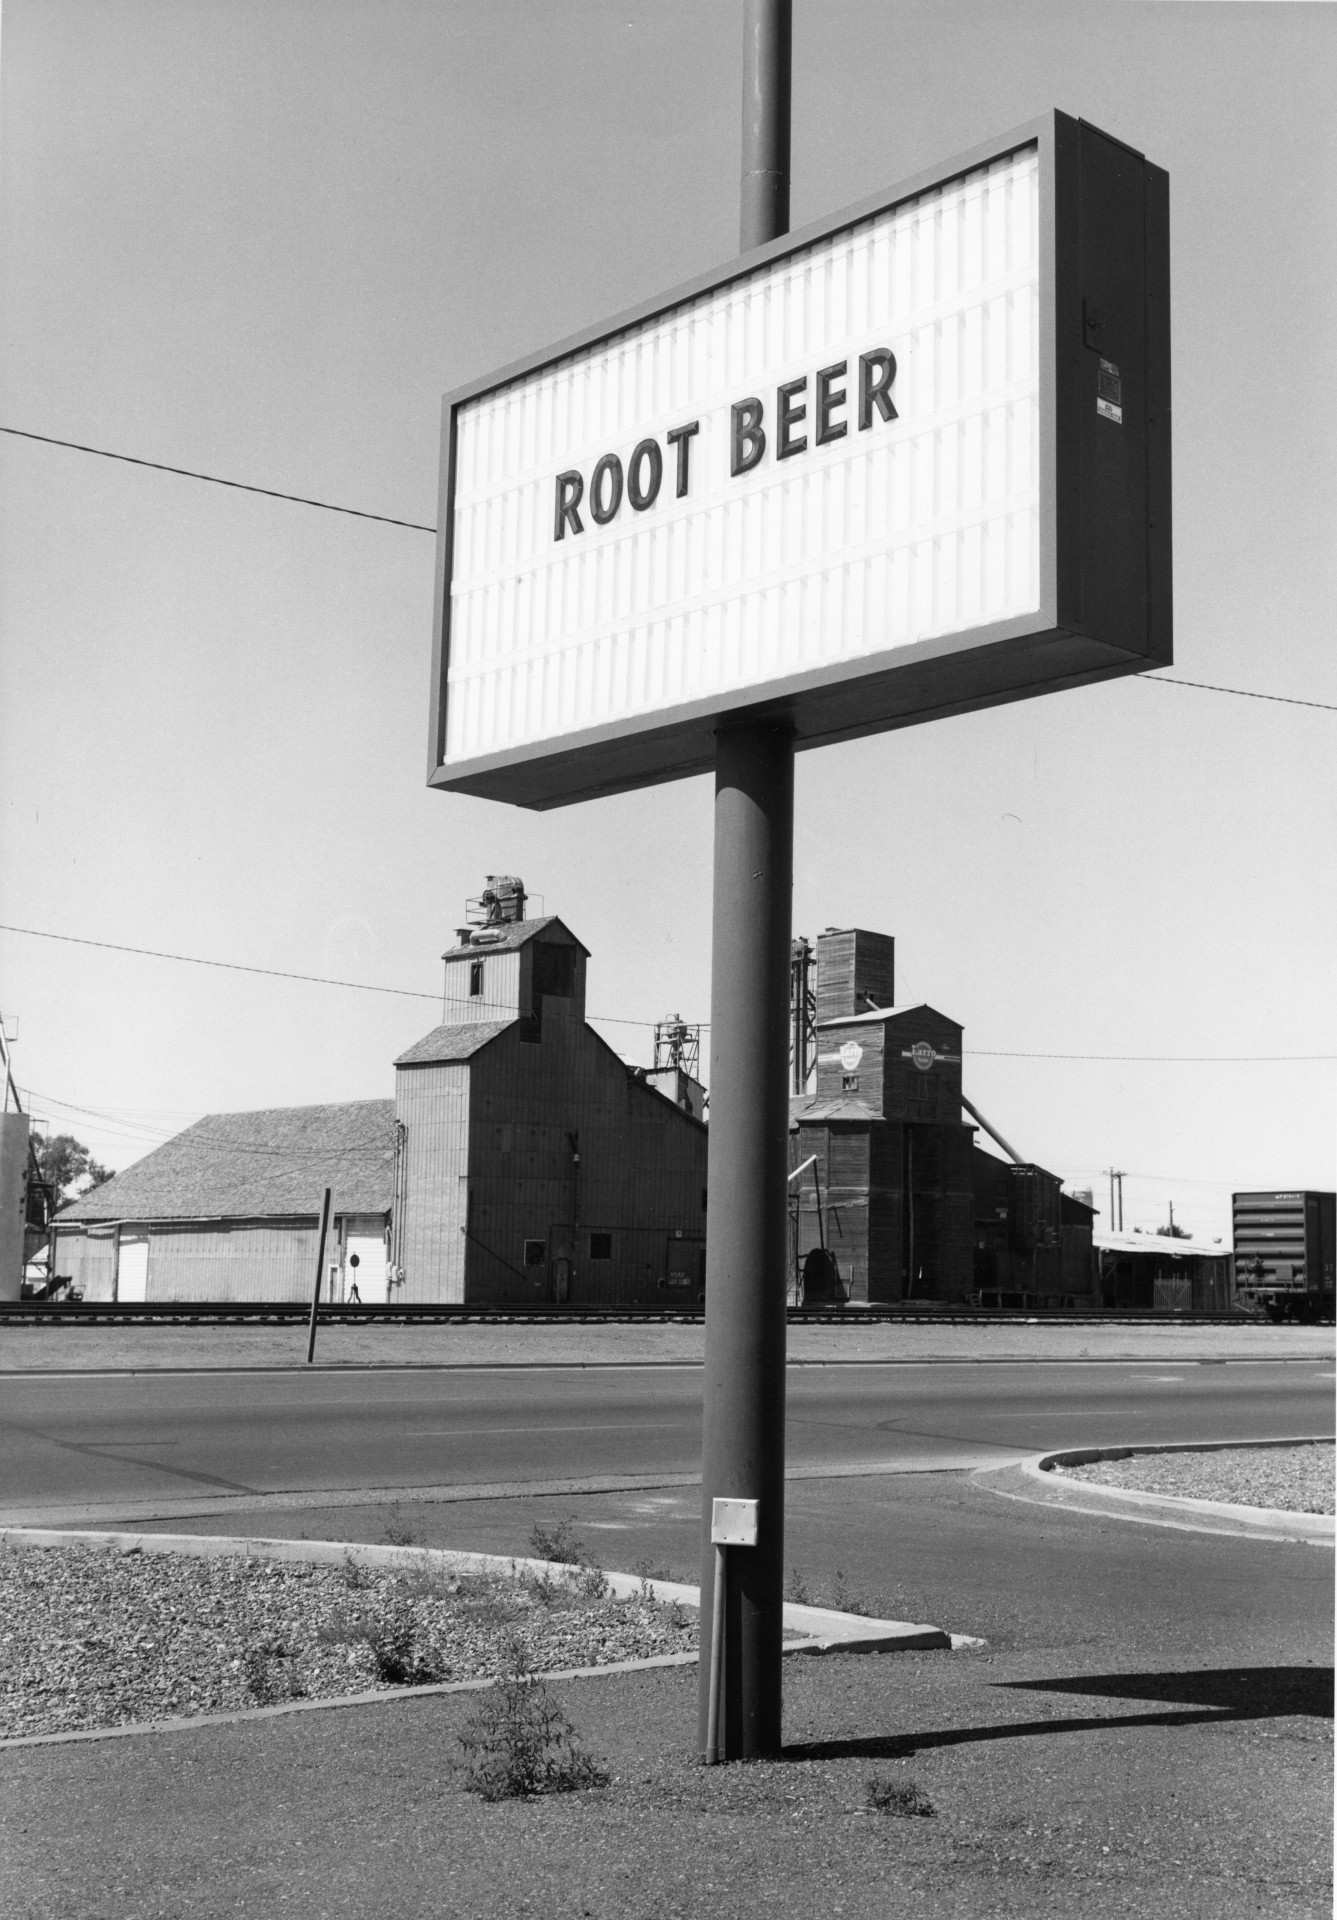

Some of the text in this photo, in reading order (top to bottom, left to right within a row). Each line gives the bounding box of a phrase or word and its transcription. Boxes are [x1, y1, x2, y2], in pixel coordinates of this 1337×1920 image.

[554, 347, 899, 542] ROOT BEER
[911, 1044, 937, 1058] Larro
